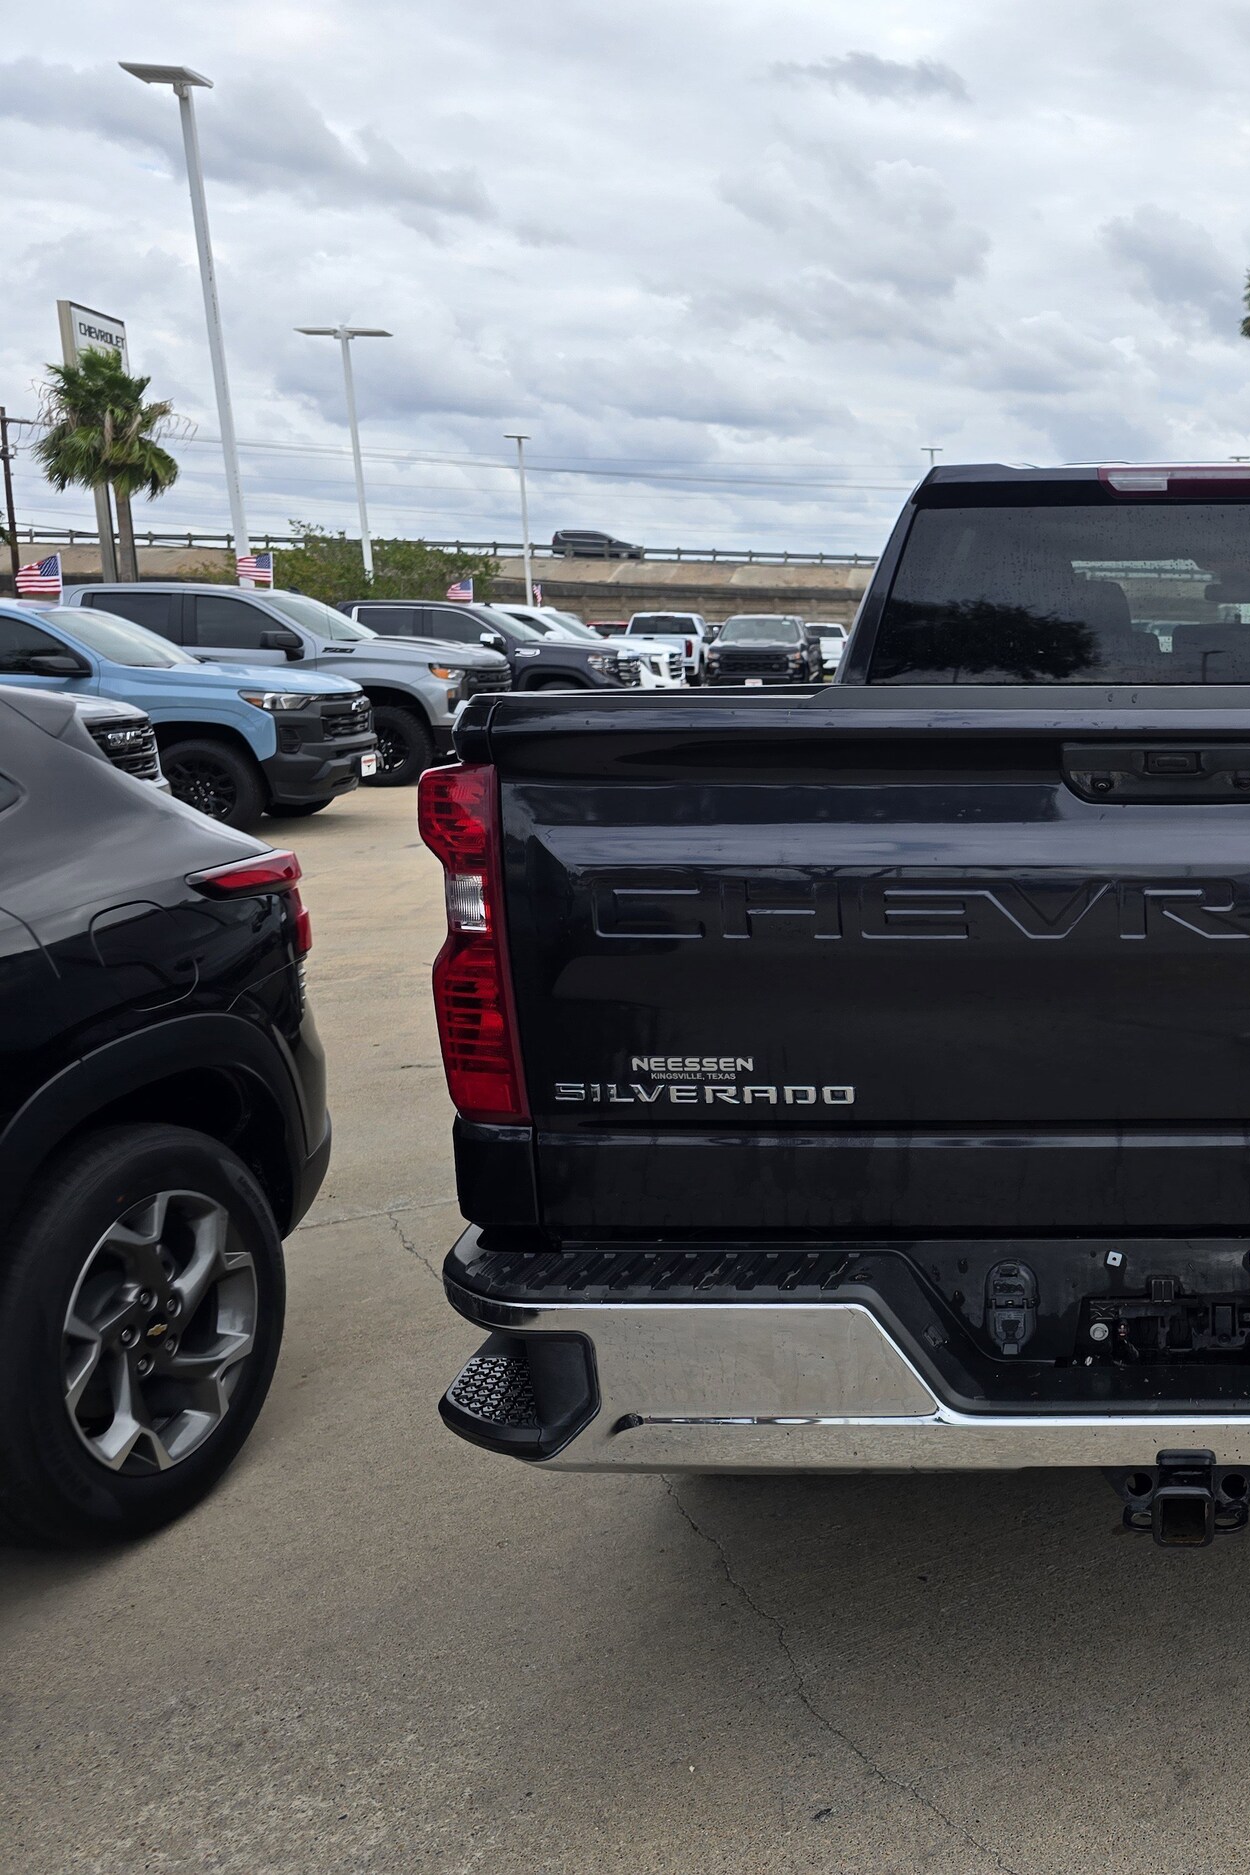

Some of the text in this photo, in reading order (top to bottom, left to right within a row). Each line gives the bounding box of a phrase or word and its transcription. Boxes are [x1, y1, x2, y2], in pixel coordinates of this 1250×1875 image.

[79, 322, 125, 349] CHEVROLET
[631, 1057, 754, 1072] NEESSEN
[554, 1083, 856, 1105] SILVERADO
